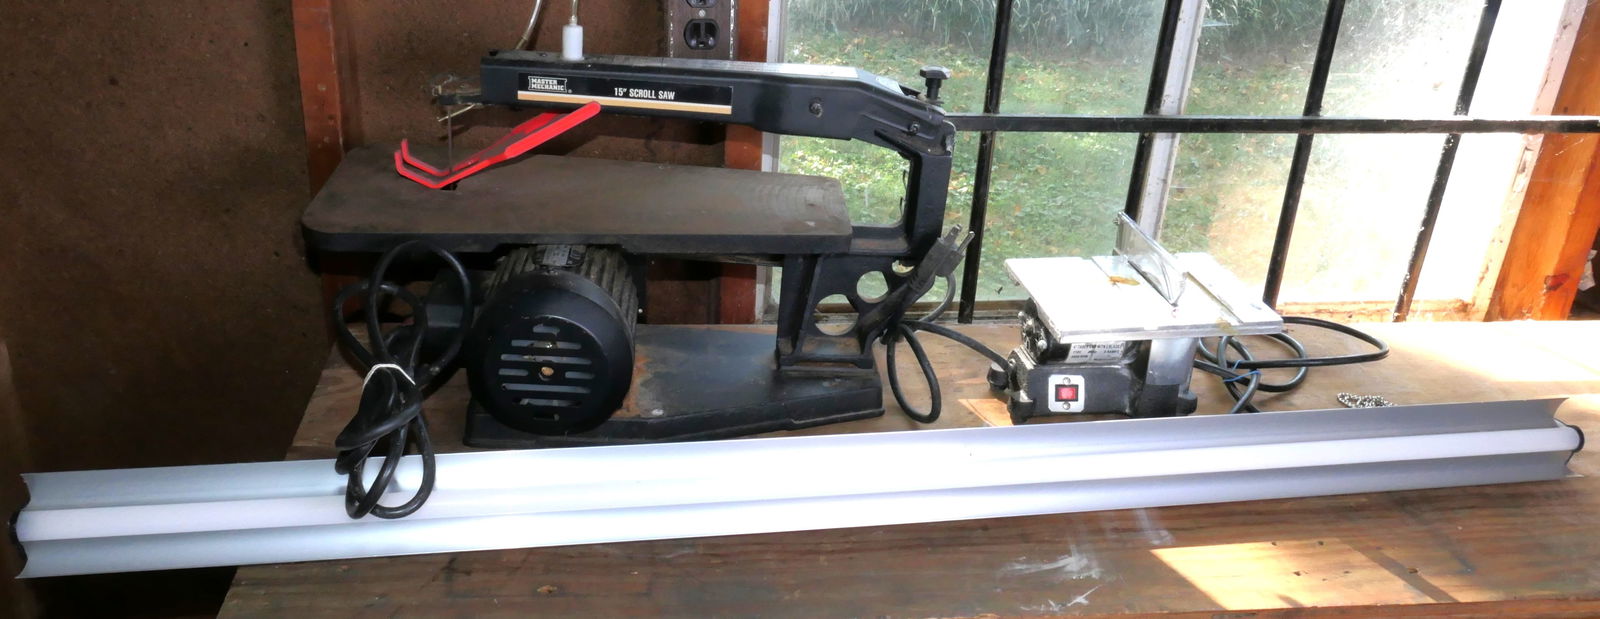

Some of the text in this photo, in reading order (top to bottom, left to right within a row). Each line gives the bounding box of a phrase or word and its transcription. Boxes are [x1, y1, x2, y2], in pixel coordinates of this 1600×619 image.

[614, 87, 675, 100] 15" SCROLL SAW
